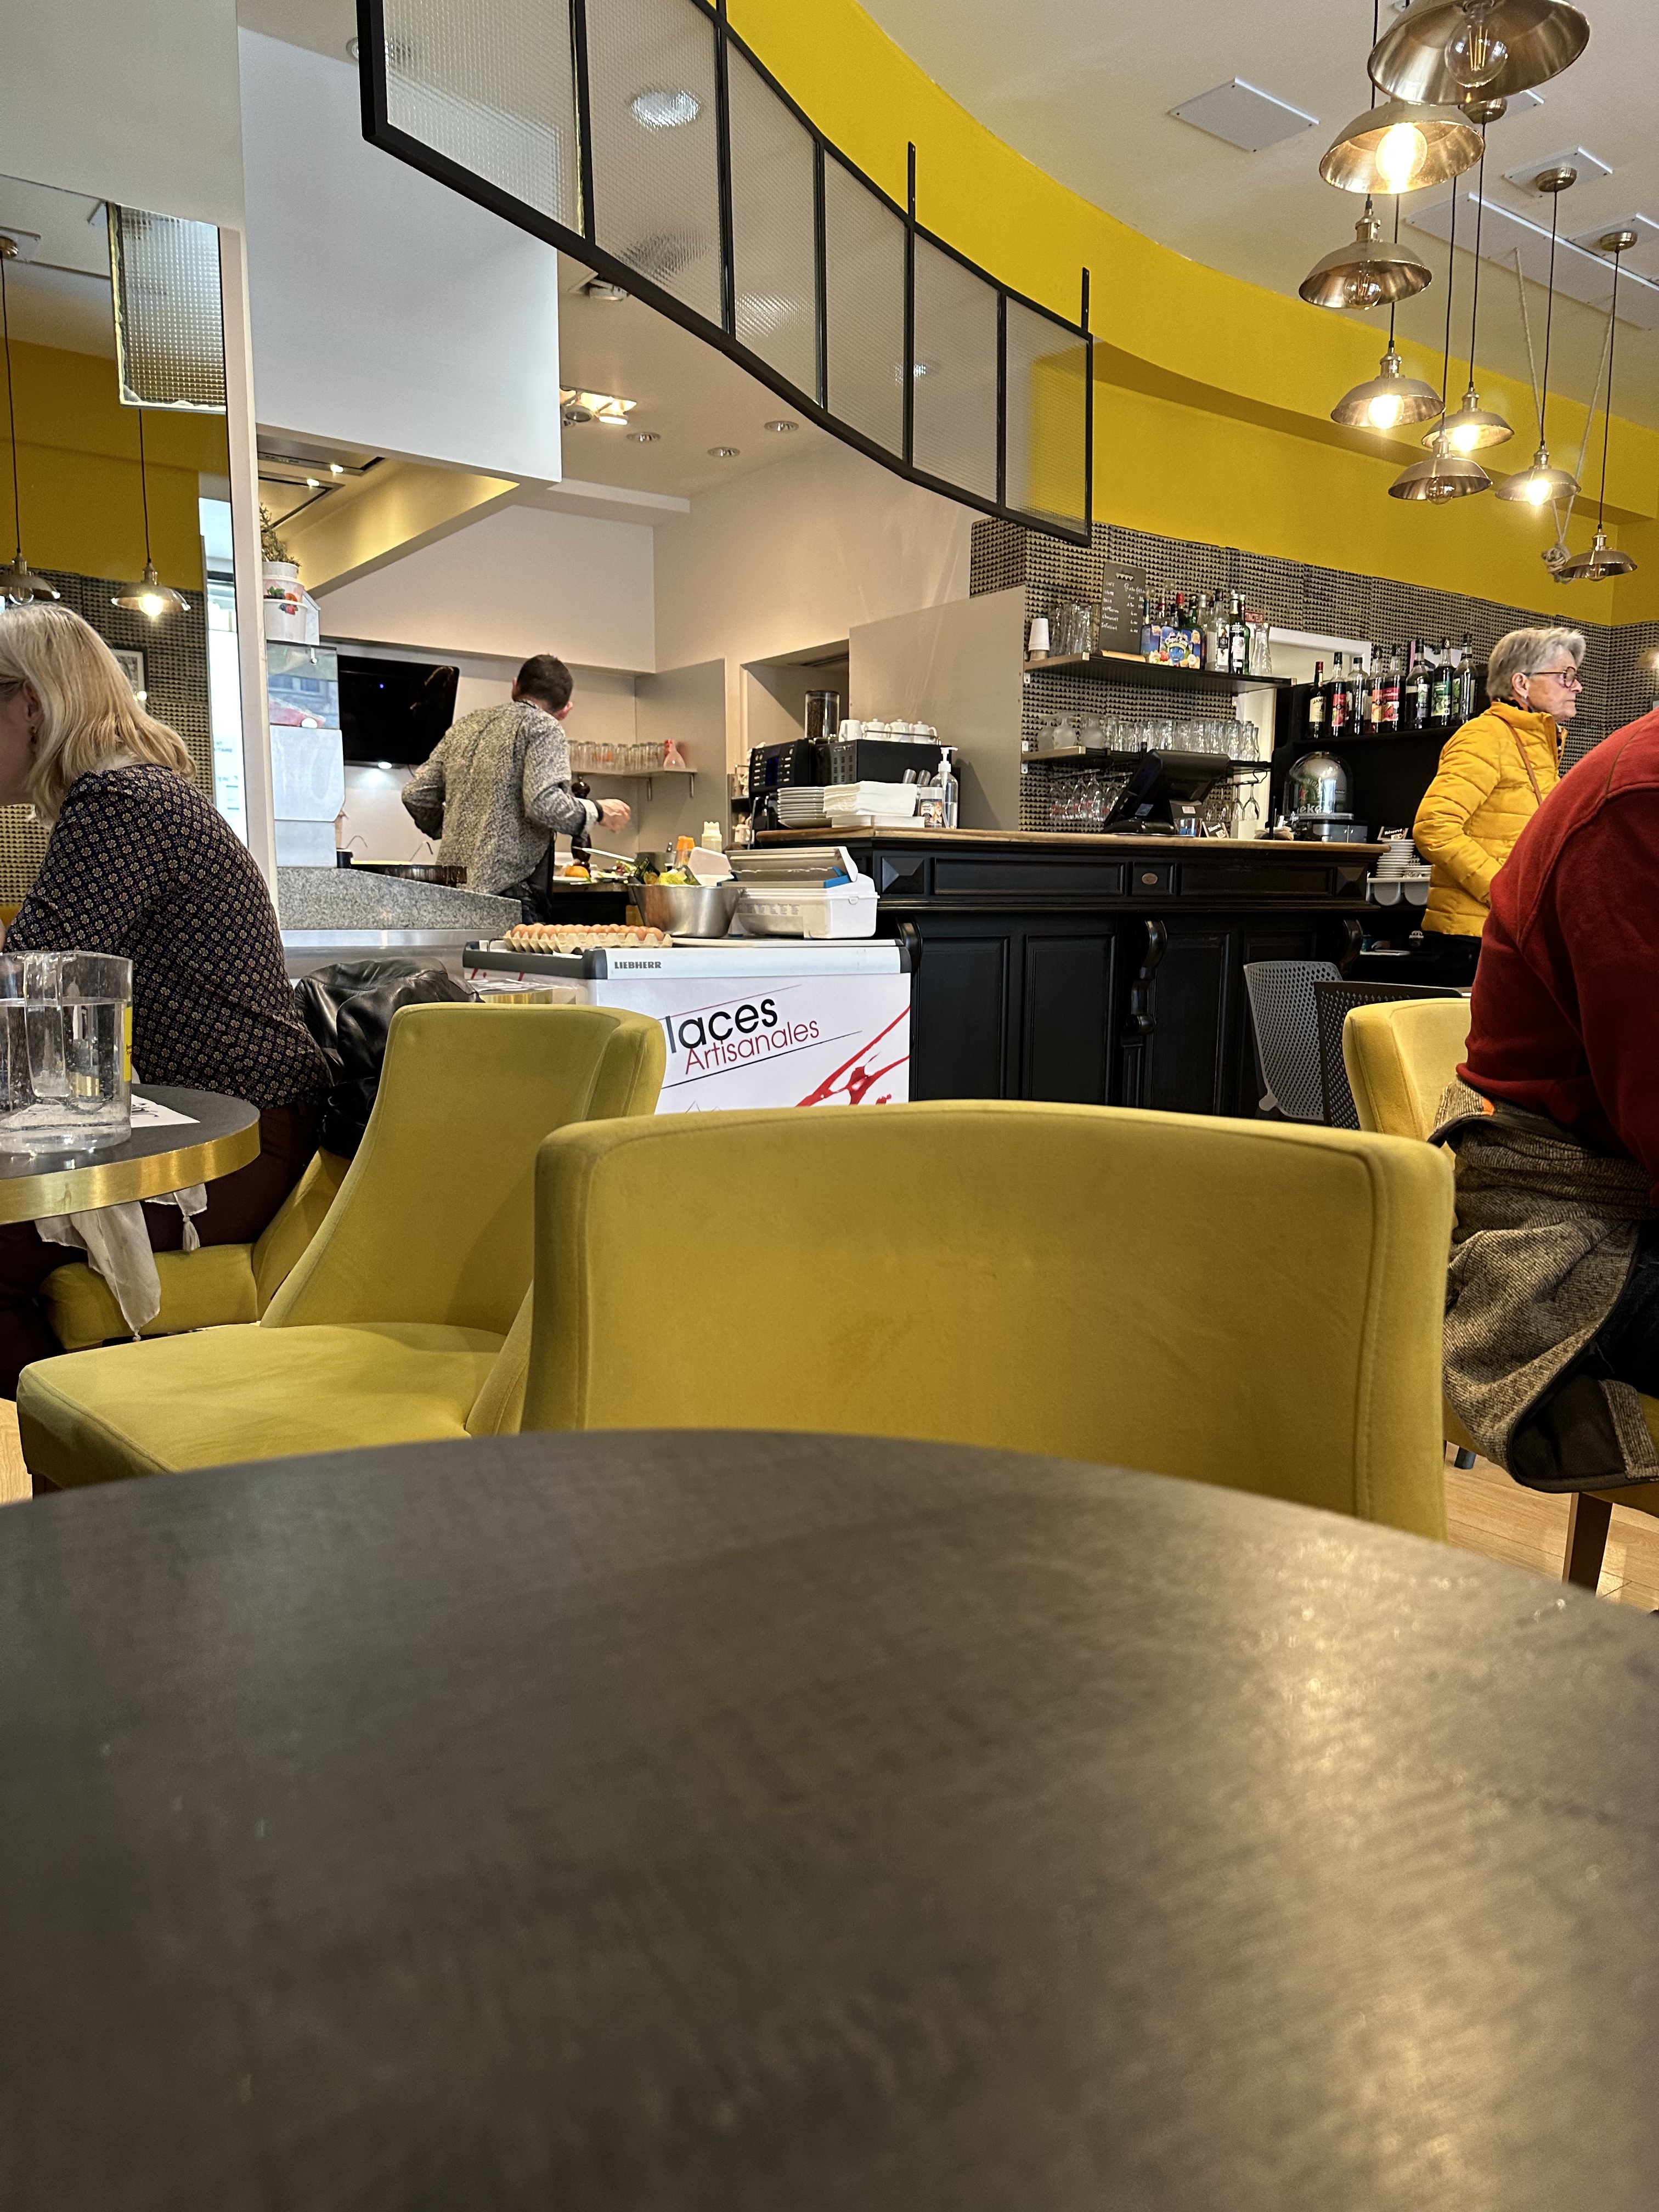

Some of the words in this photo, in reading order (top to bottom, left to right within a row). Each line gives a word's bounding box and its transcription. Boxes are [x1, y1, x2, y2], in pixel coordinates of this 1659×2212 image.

[614, 961, 662, 969] LIEBHERR
[665, 998, 778, 1054] laces
[685, 1019, 820, 1075] Artisanales
